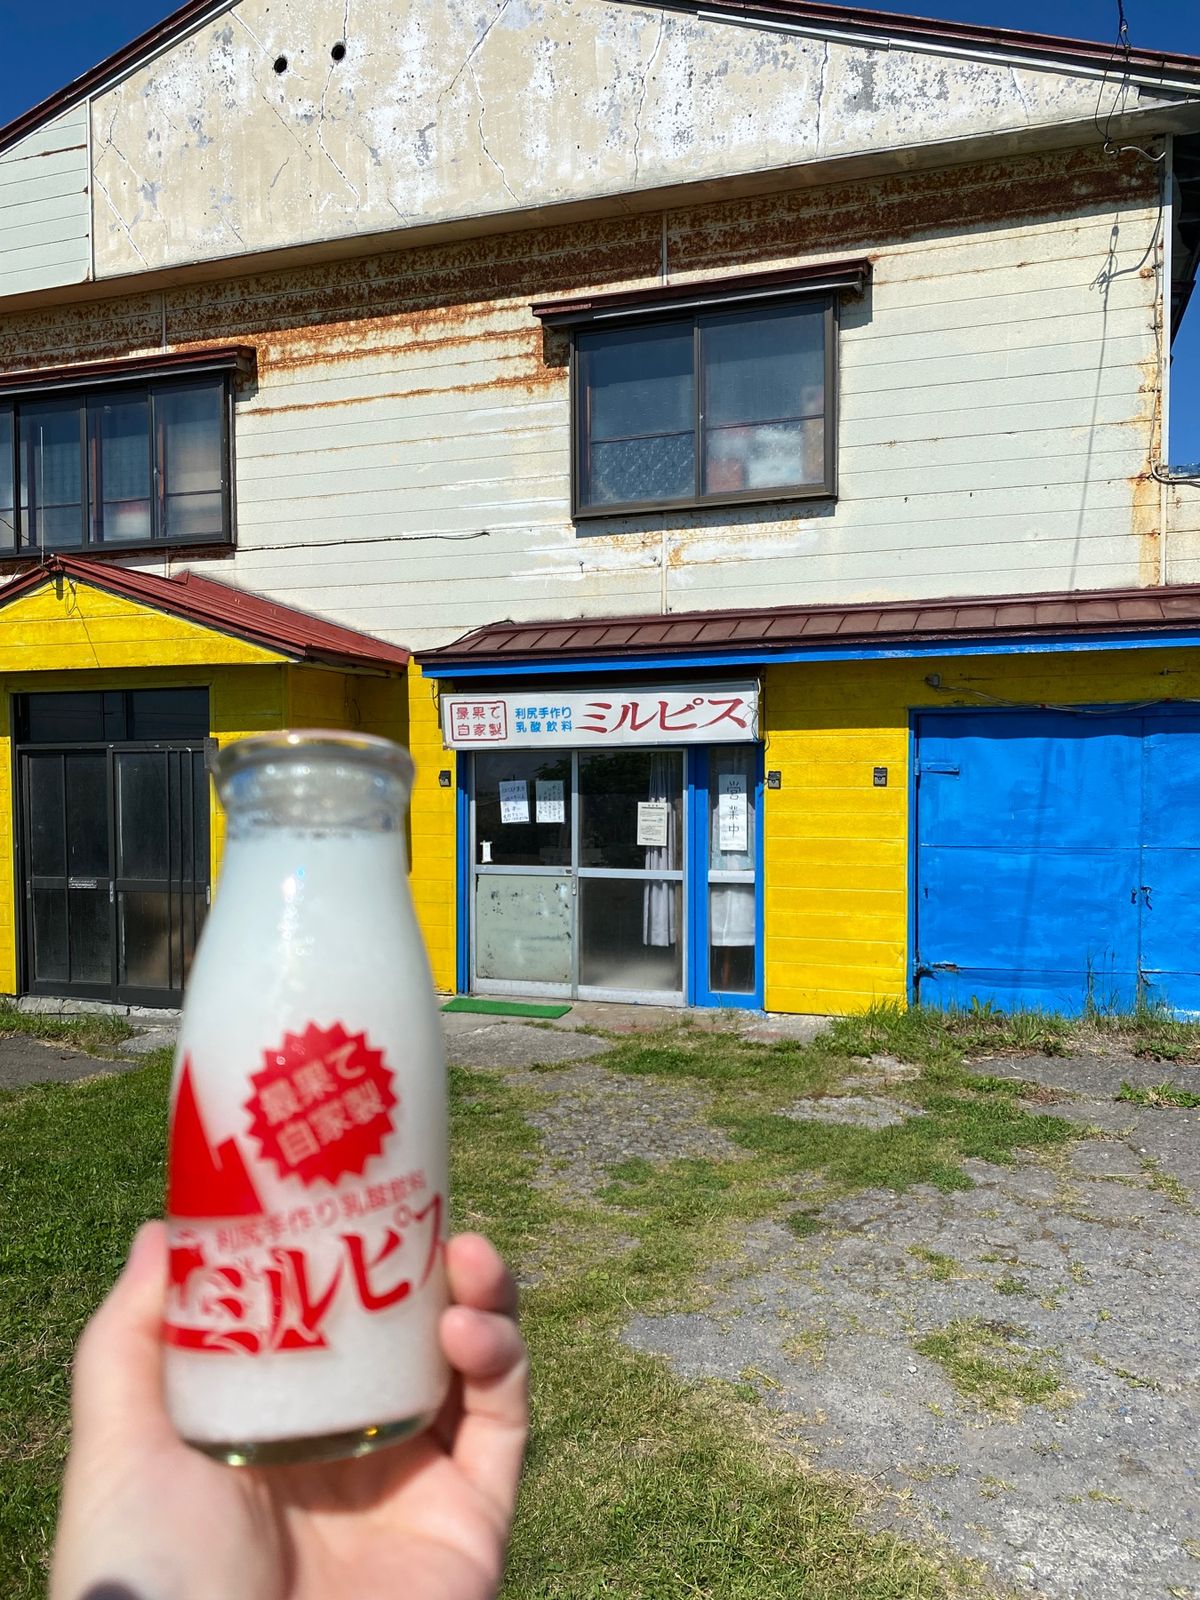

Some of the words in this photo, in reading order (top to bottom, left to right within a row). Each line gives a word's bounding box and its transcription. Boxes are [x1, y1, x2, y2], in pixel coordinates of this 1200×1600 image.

[515, 707, 572, 720] 利尻手作り
[575, 697, 747, 734] ミルピス
[457, 722, 502, 737] 自家製
[515, 721, 572, 733] 乳酸飲料
[726, 780, 741, 839] 営業中
[275, 1077, 387, 1168] 自家製
